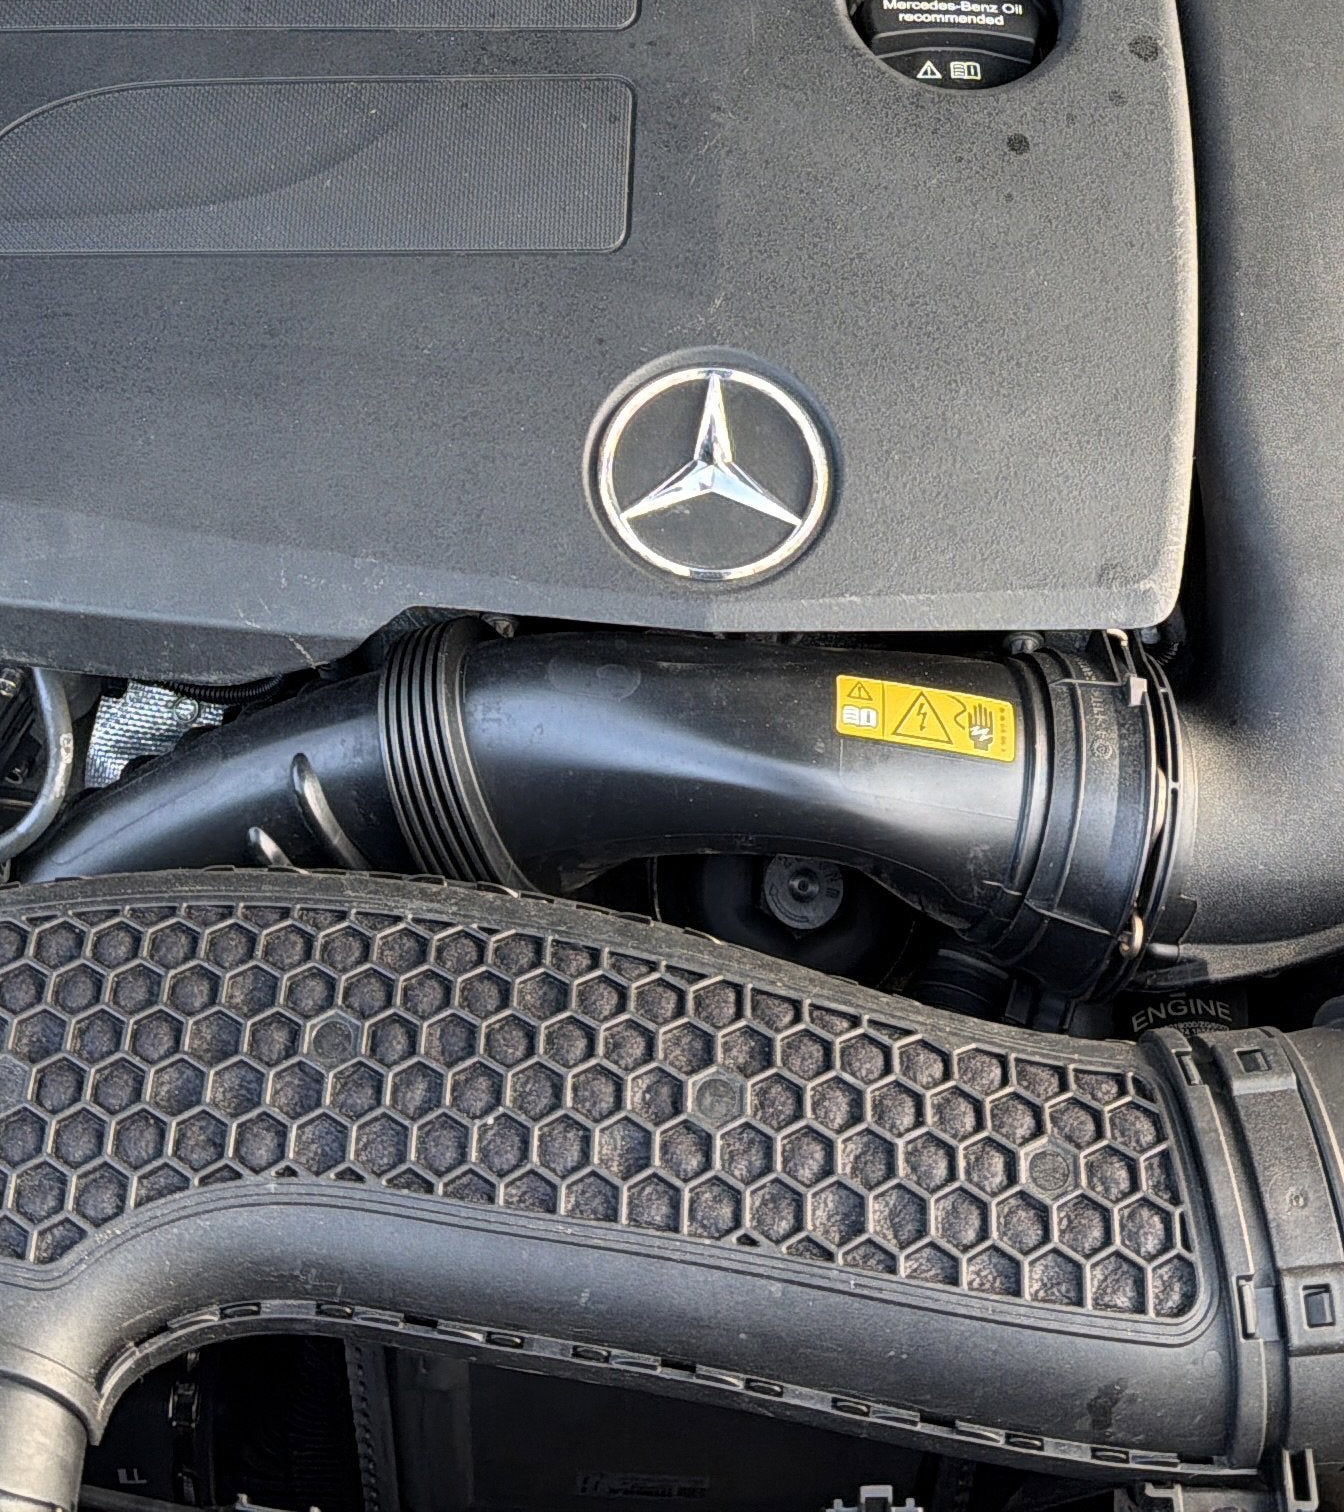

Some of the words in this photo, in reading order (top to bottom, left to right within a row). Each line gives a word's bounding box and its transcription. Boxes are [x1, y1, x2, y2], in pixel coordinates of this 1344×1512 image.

[883, 0, 998, 14] Mercedes-Benz
[1002, 4, 1023, 16] Oil
[899, 12, 1004, 26] recommended
[1131, 998, 1233, 1033] ENGINE
